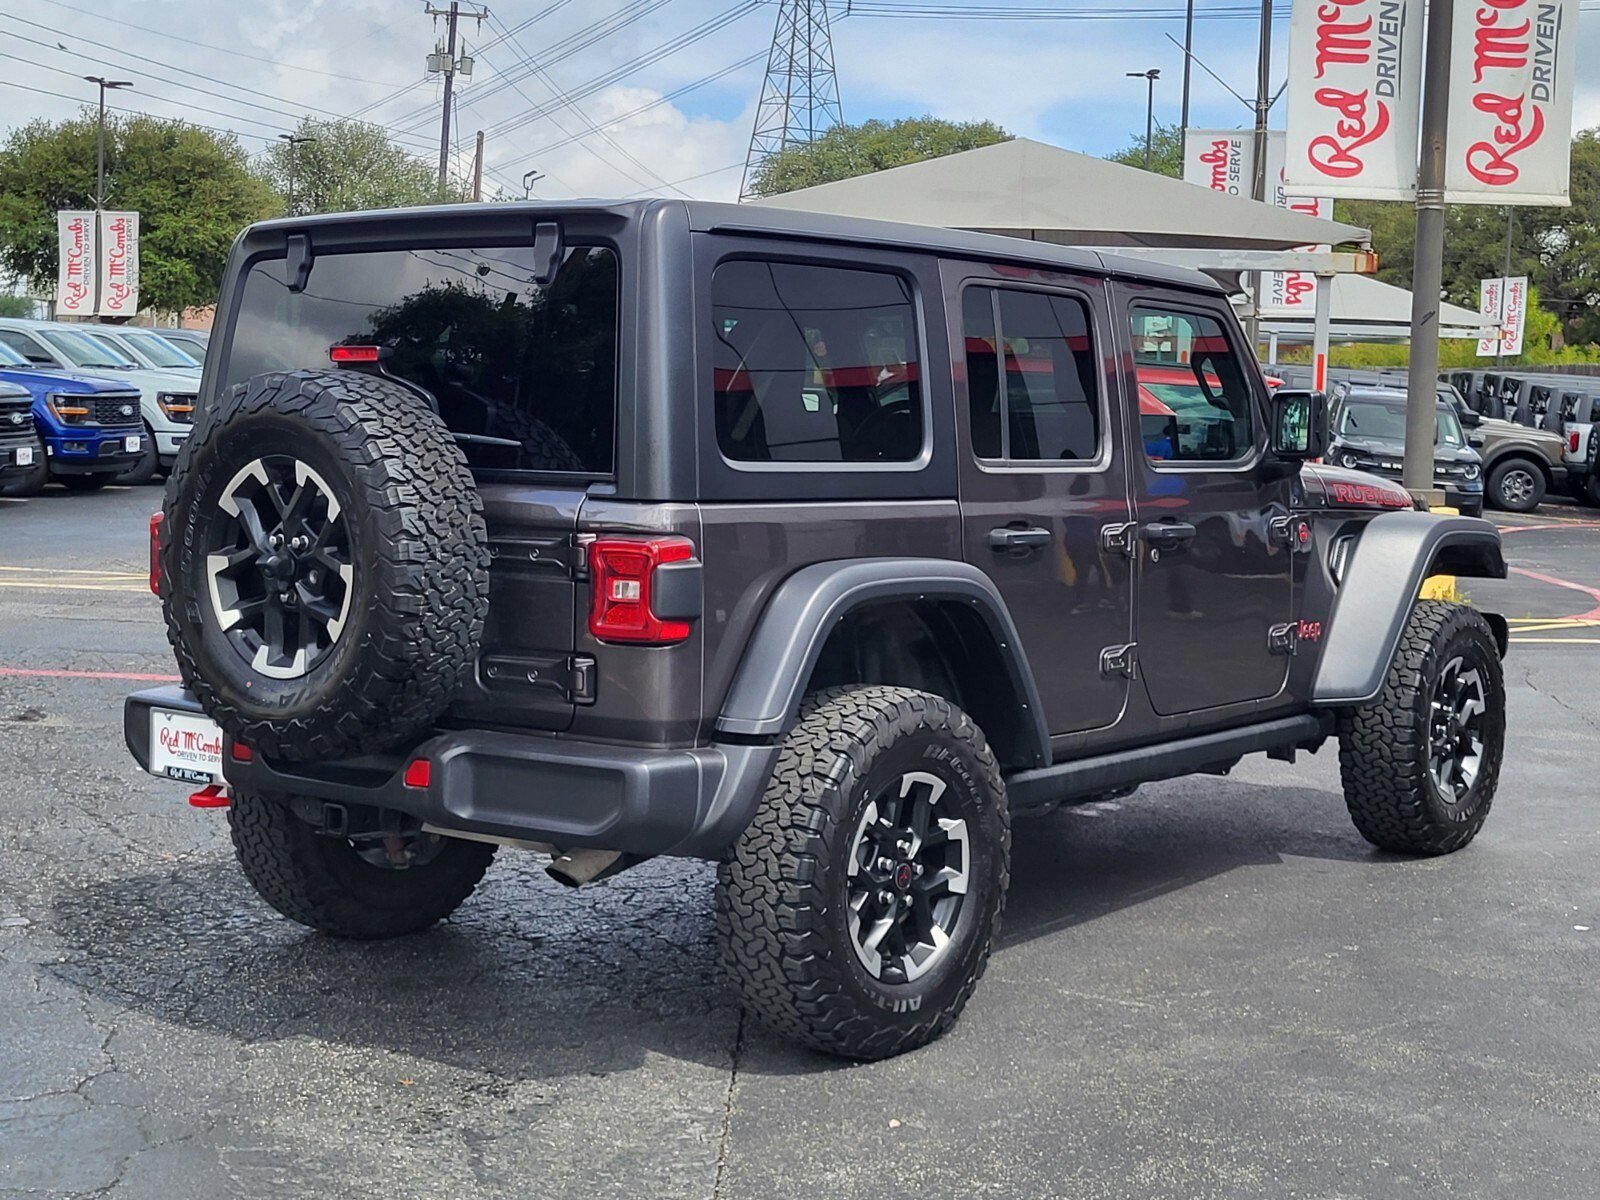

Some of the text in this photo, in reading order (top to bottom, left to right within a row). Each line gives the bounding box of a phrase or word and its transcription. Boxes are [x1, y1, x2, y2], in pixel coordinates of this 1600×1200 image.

[1375, 1, 1400, 98] DRIVEN
[1531, 4, 1556, 102] DRIVEN
[1308, 88, 1390, 178] Red
[1466, 92, 1544, 186] Red
[1230, 140, 1241, 182] SERVE
[84, 243, 90, 254] TO
[126, 243, 133, 254] TO
[64, 282, 87, 309] Red
[107, 283, 130, 310] Red
[1272, 272, 1283, 305] ERVE
[1298, 620, 1321, 642] Jeep
[160, 727, 179, 754] Red
[177, 750, 197, 760] DRIVEN
[198, 753, 206, 762] TO
